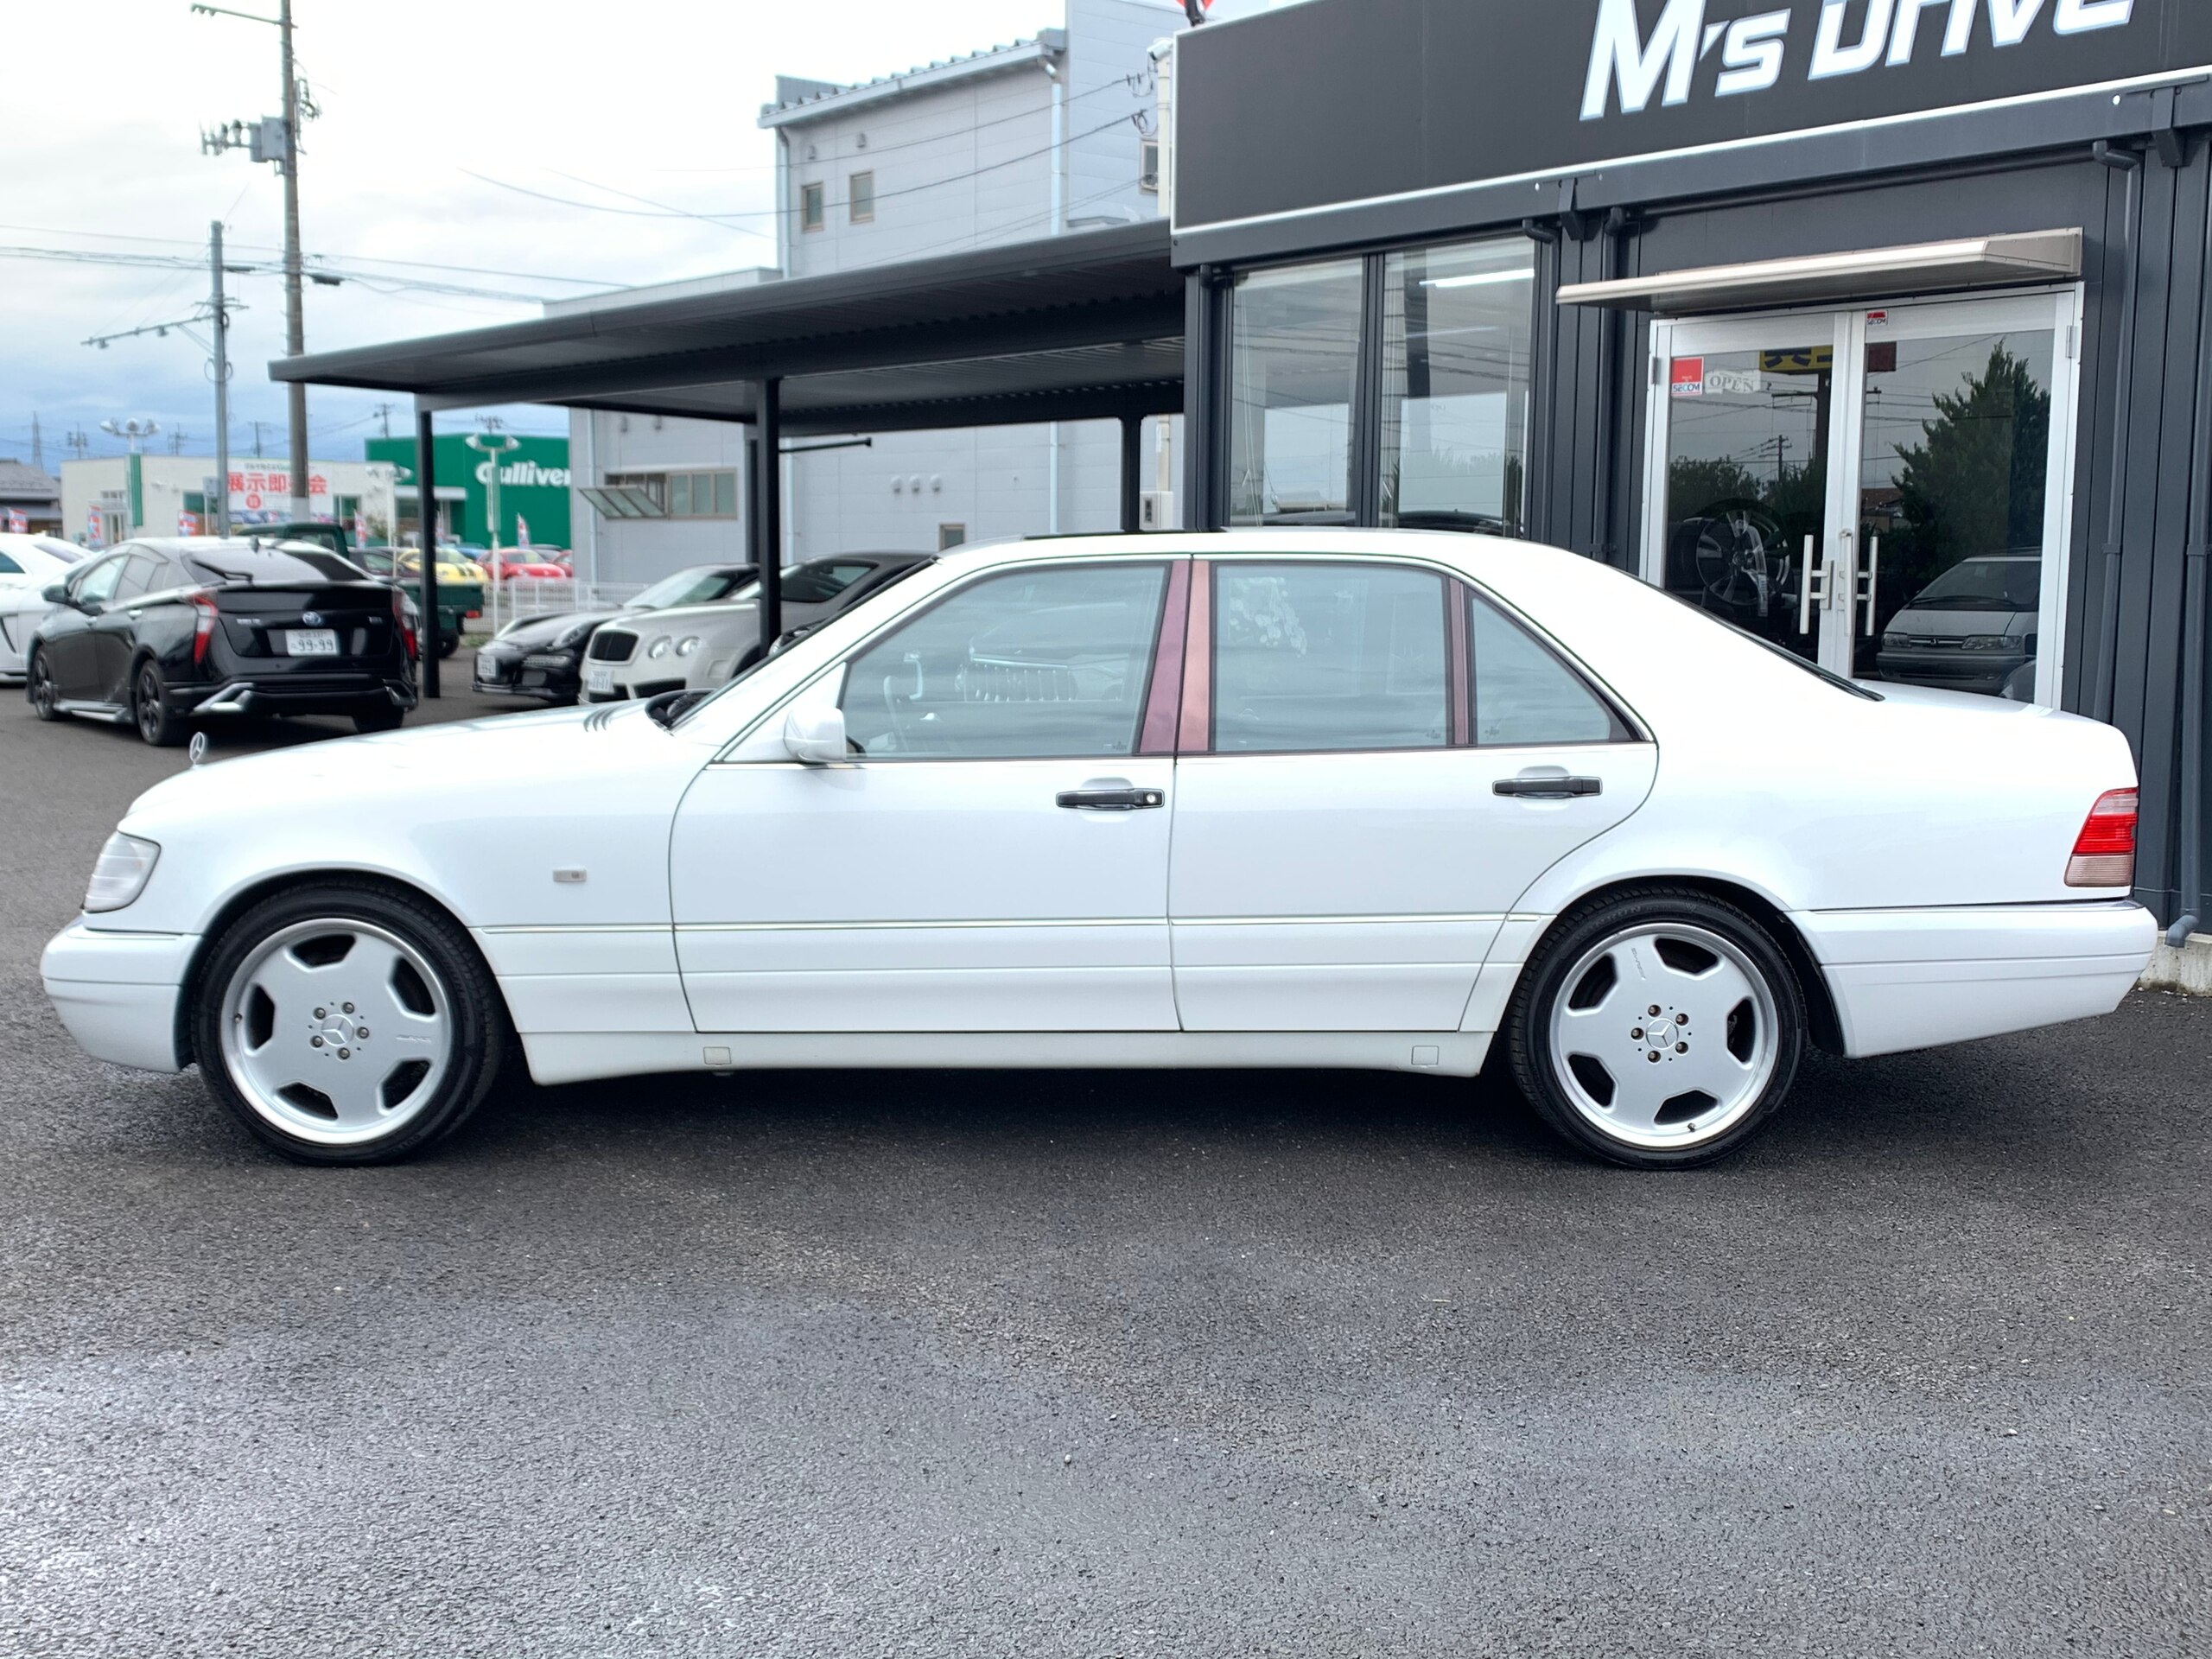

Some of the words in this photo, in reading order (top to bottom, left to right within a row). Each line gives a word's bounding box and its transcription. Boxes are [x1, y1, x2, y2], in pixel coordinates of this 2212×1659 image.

[1673, 384, 1700, 392] SECOM
[1709, 375, 1754, 392] OPEN
[227, 472, 327, 494] 展示即会
